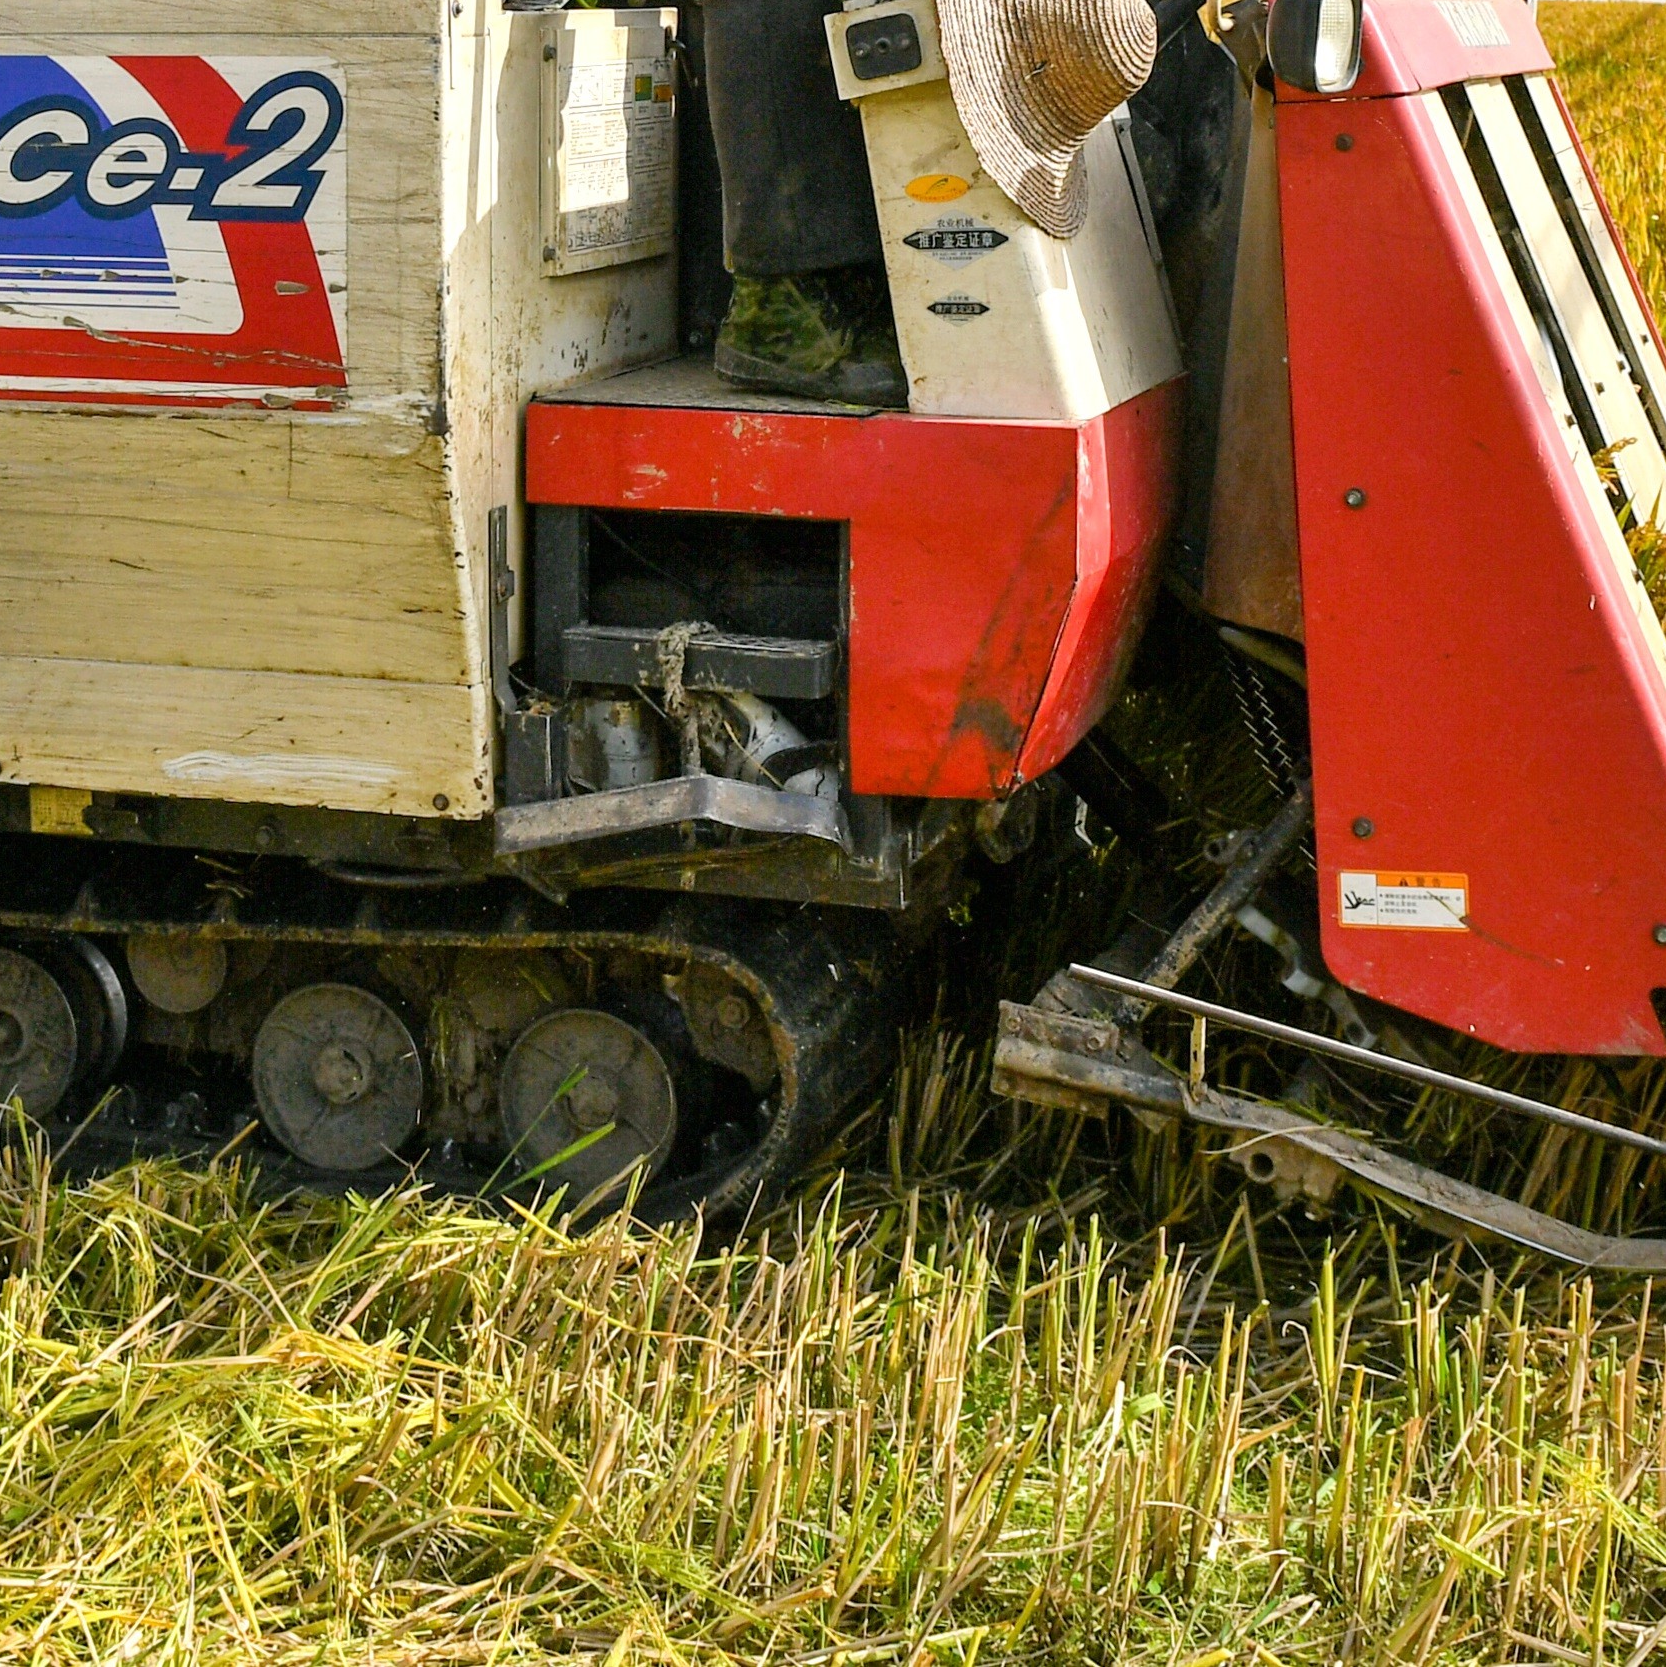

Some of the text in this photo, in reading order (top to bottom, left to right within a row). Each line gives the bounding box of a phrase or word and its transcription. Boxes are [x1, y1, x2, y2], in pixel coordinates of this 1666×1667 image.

[918, 232, 993, 248] 推广鉴定证章
